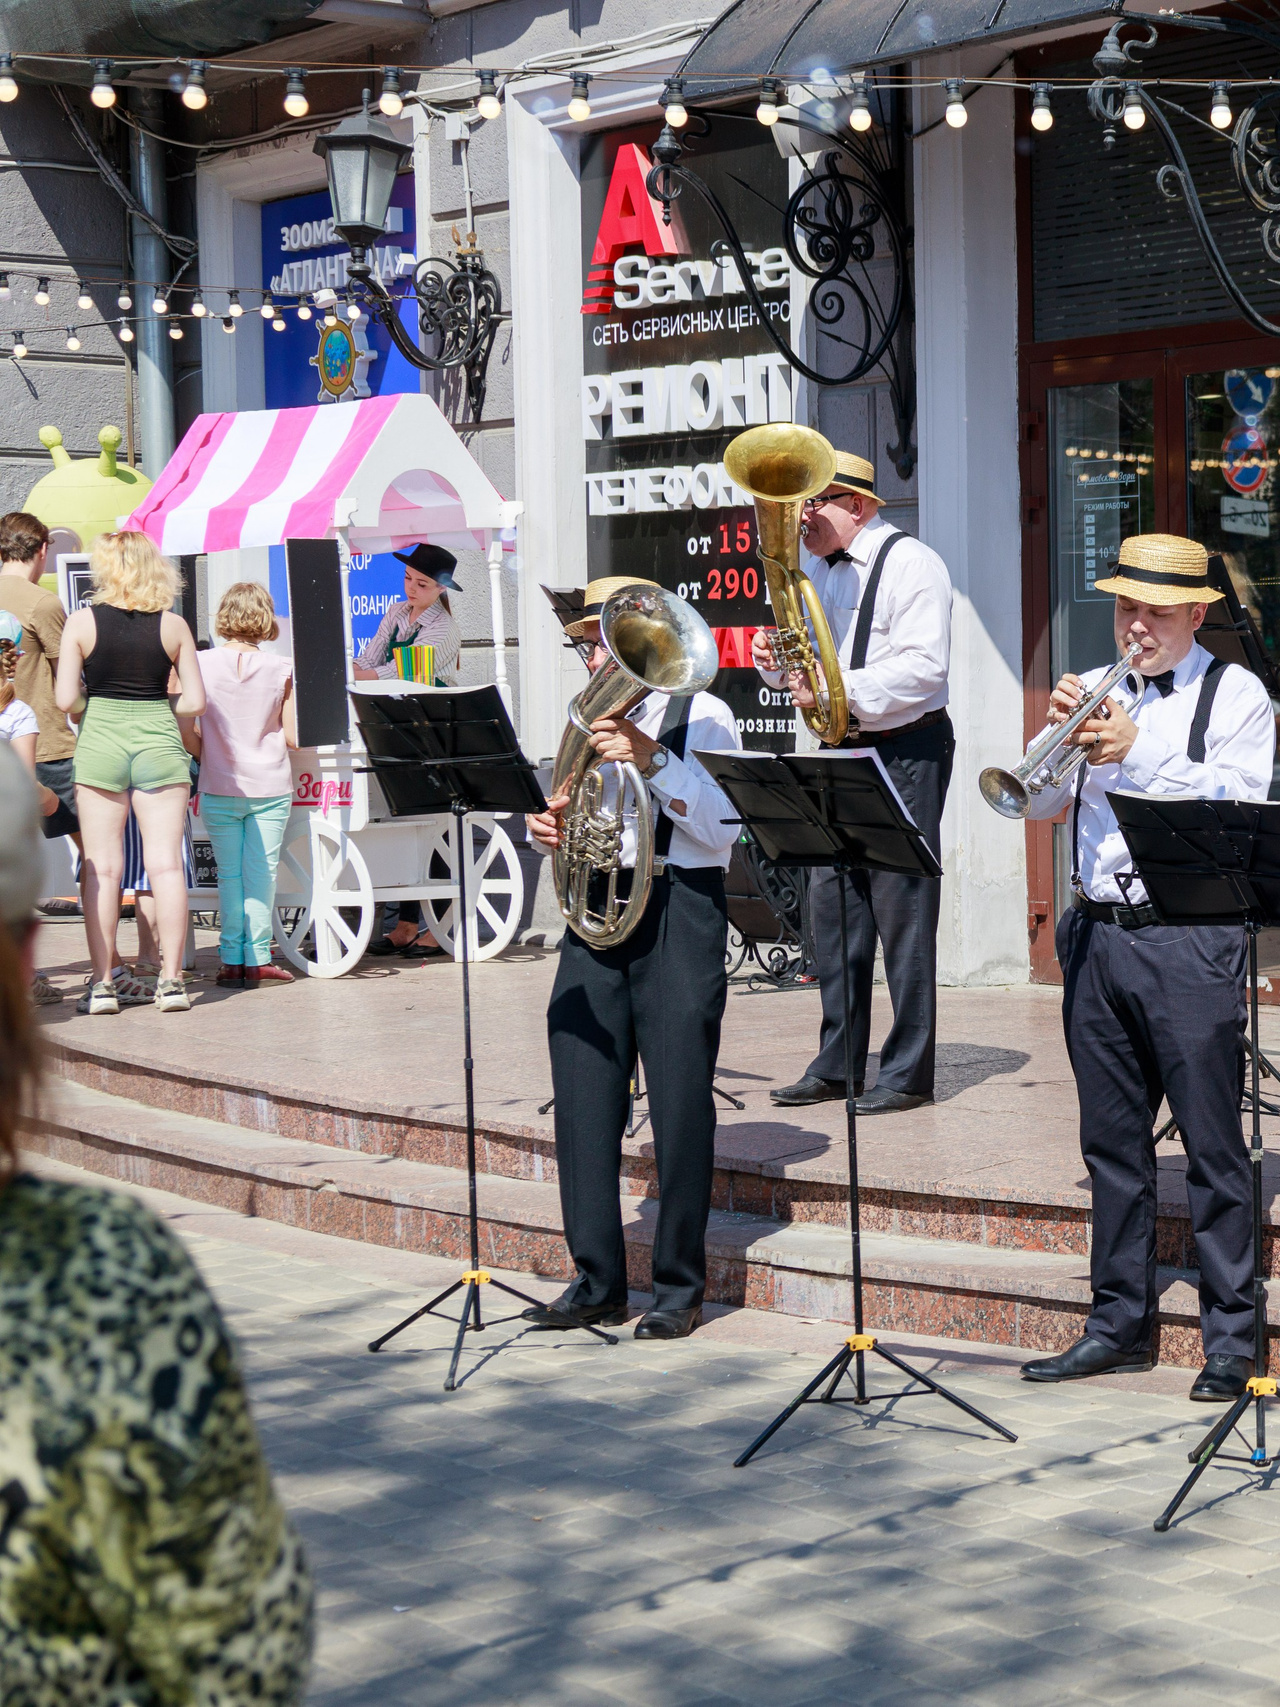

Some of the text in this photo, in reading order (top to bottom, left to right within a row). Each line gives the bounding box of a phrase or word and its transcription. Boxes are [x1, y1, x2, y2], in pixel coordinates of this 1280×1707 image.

[270, 246, 417, 294] «АТЛАНТДА»
[614, 248, 790, 308] Service
[593, 323, 629, 346] СЕТЬ
[632, 308, 724, 342] СЕРВИСНЫХ
[581, 352, 792, 440] РЕМОНТ
[1084, 501, 1130, 512] РЕЖИМ РАБОТЫ
[687, 536, 712, 555] от
[720, 521, 750, 554] 15
[677, 582, 702, 600] от
[707, 568, 758, 600] 290
[758, 687, 793, 707] Опт
[297, 772, 354, 818] Зори
